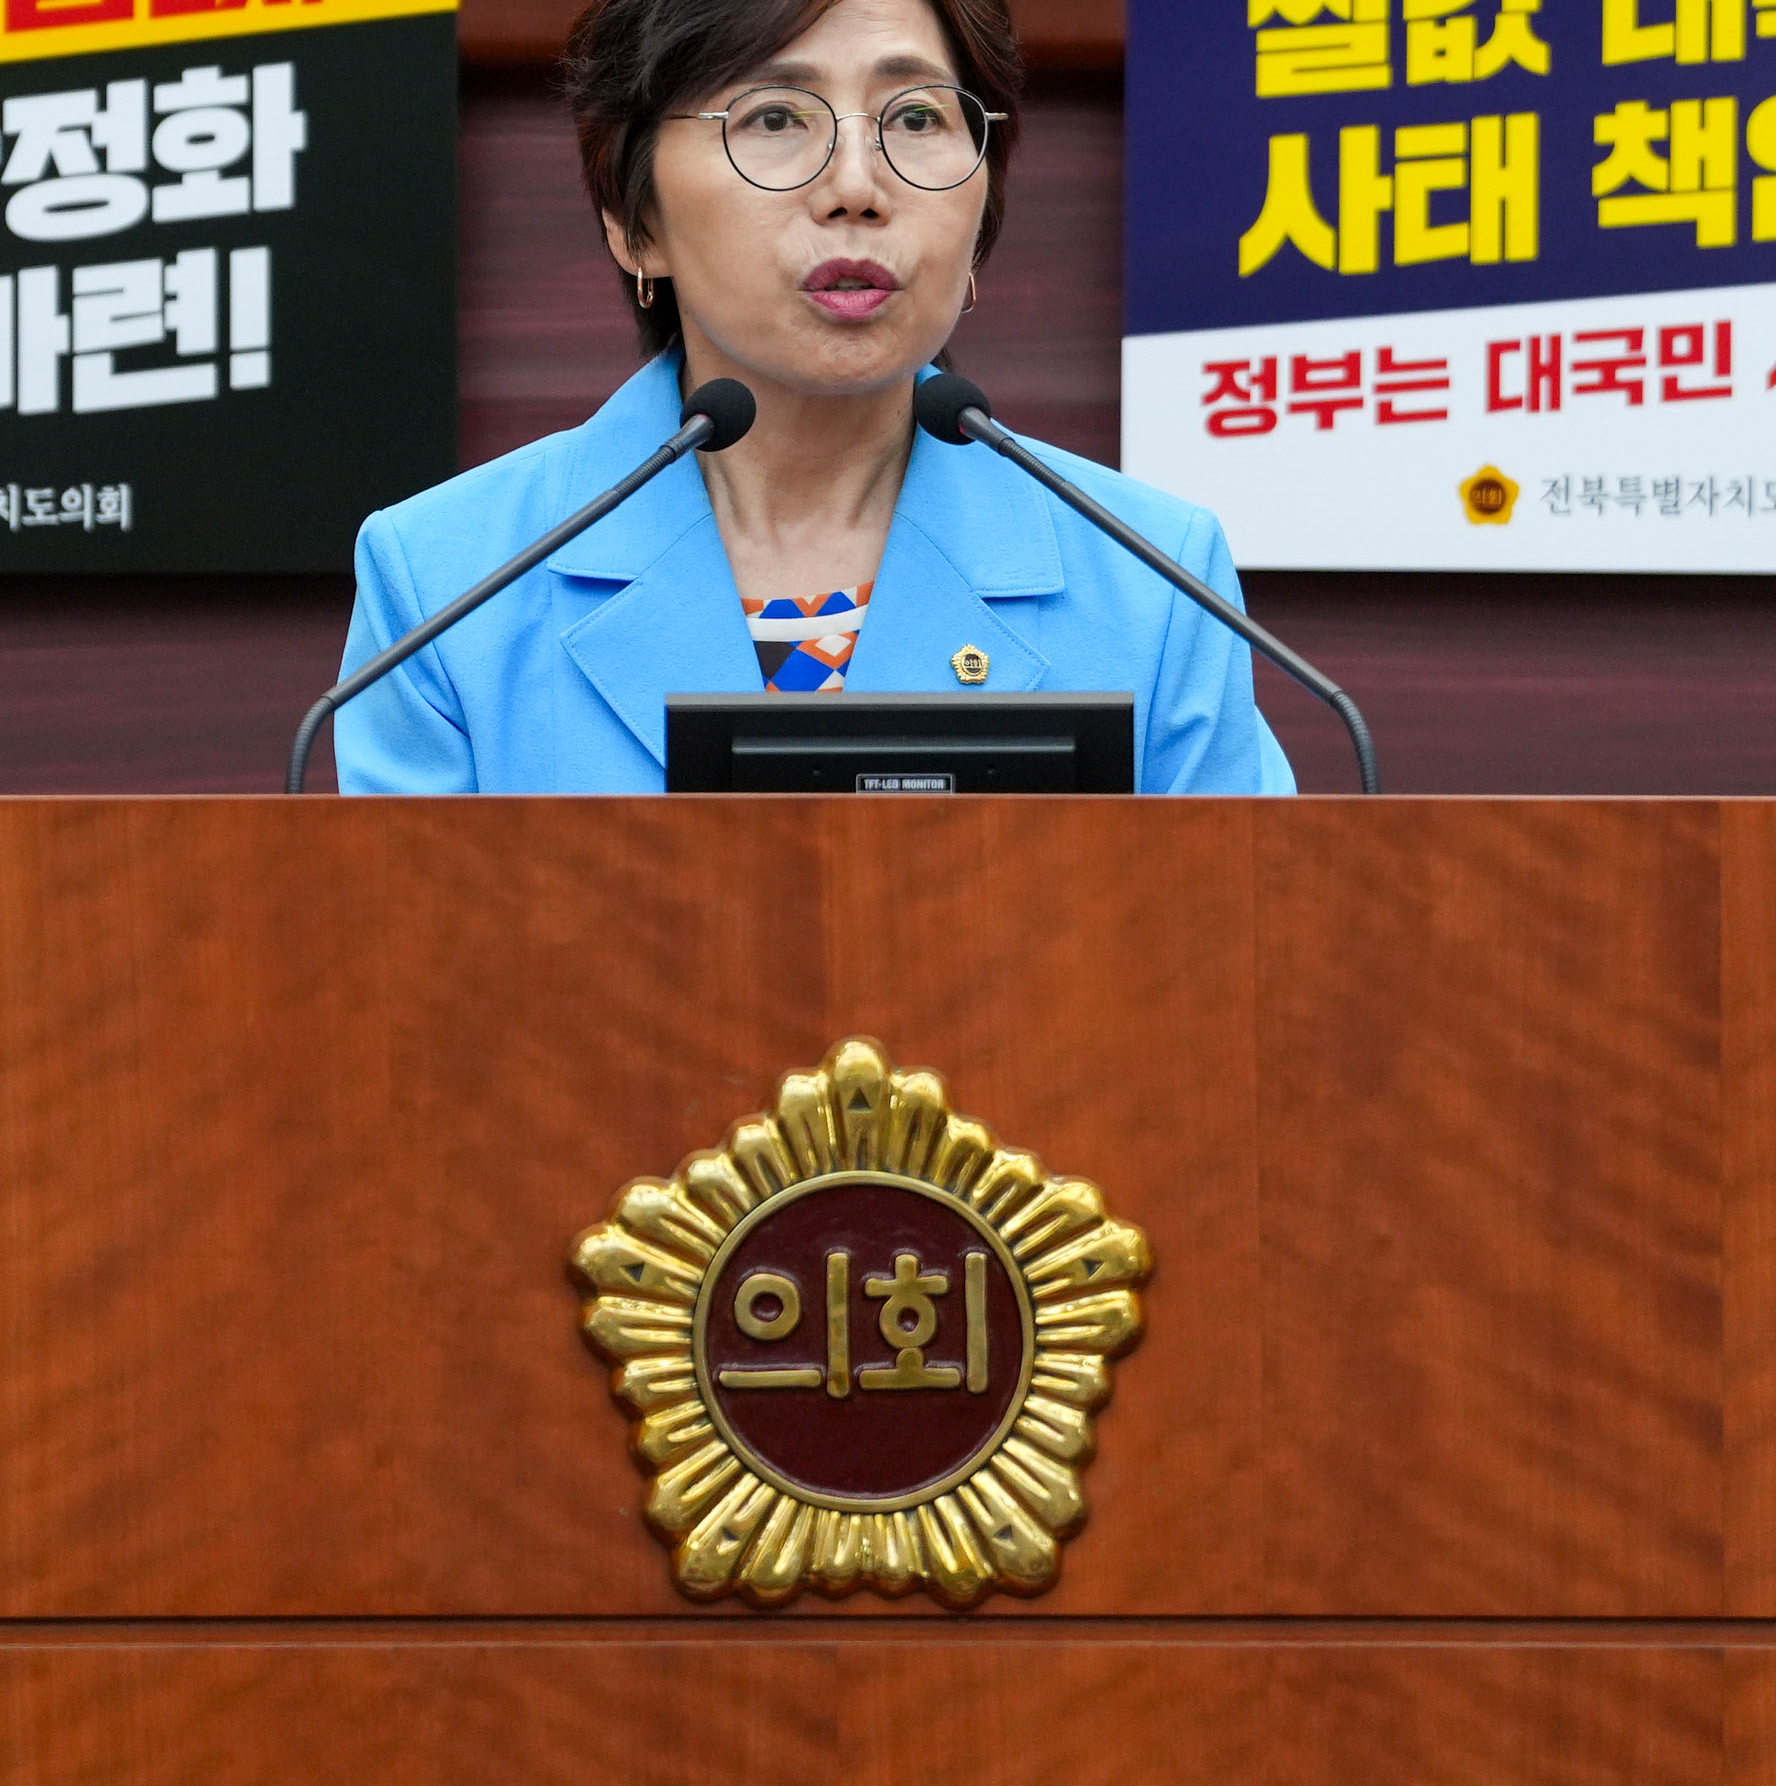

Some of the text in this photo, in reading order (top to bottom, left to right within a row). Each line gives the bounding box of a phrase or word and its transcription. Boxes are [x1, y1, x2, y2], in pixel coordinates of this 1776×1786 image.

[1238, 112, 1539, 277] 사태
[1201, 346, 1450, 438] 정부는
[1486, 320, 1732, 413] 대국민
[902, 779, 944, 789] MONITOR
[720, 1253, 988, 1398] 의회
